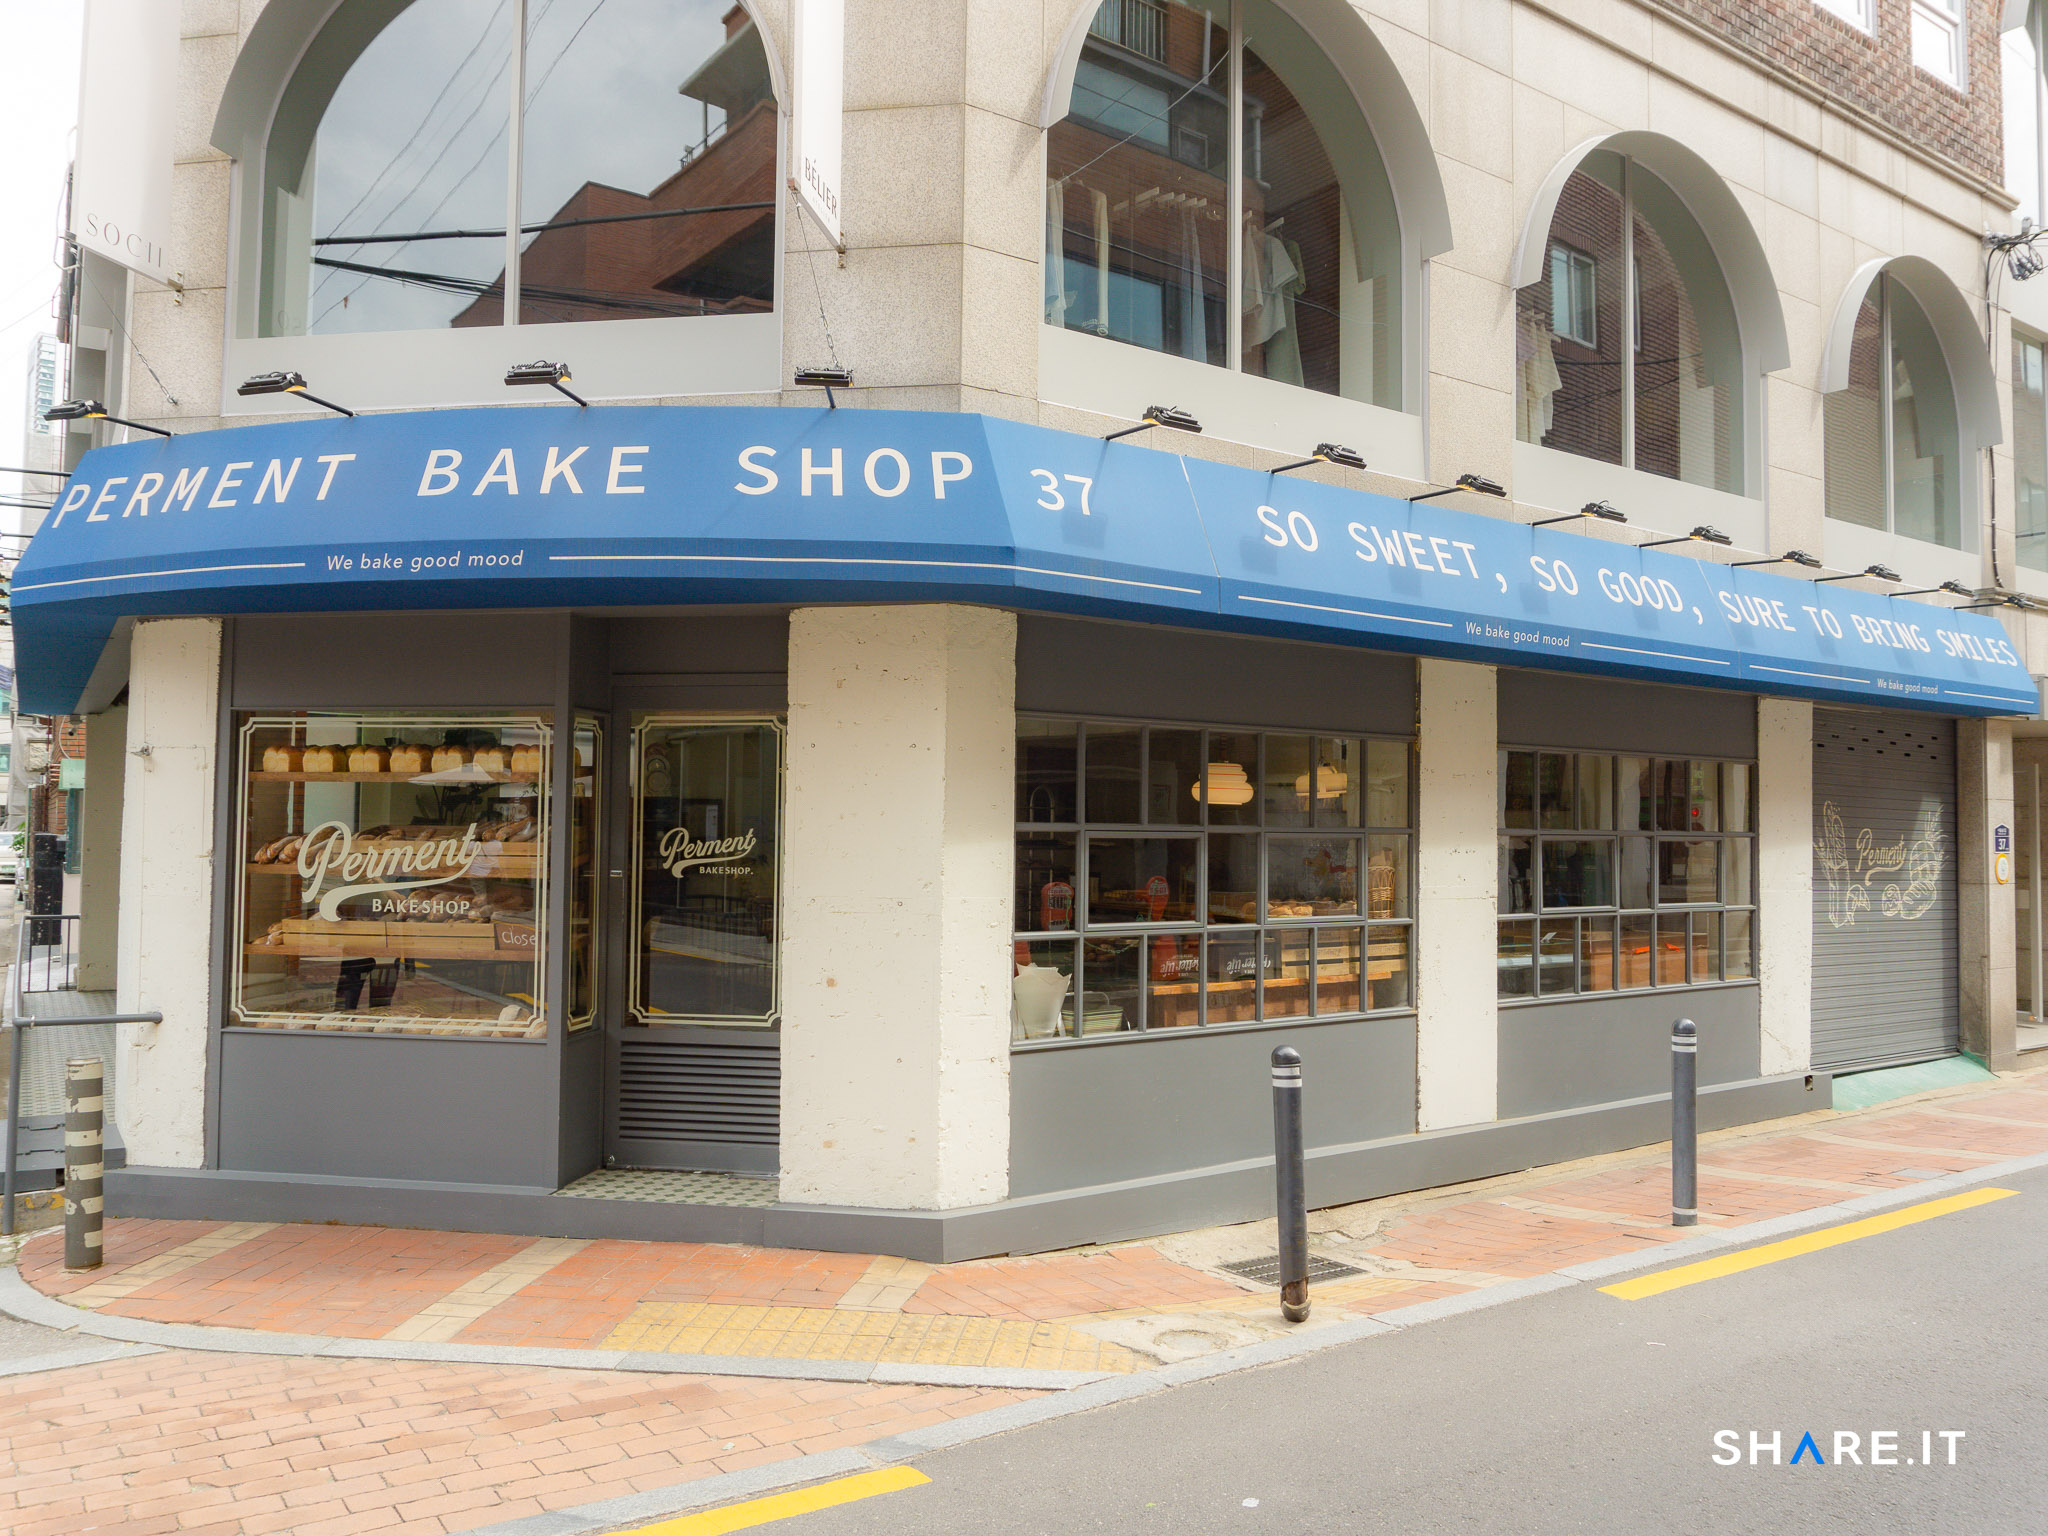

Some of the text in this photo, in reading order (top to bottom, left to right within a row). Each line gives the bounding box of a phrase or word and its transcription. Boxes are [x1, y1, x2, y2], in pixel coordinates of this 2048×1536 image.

[805, 157, 837, 219] BÉLIER
[51, 445, 973, 529] PERMENT BAKE SHOP
[1029, 468, 1093, 516] 37
[327, 550, 524, 572] We bake good mood
[1256, 505, 1319, 552] SO
[1530, 555, 1579, 596] SO
[1718, 590, 1797, 632] SURE
[1801, 605, 1843, 639] TO
[1849, 613, 1931, 653] BRING
[1935, 628, 2018, 667] SMILES
[1465, 621, 1570, 647] We bake good mood
[1877, 678, 1939, 694] We bake good mood
[298, 820, 482, 904] Perment
[659, 827, 757, 869] Perment
[372, 898, 471, 915] BAKESHOP
